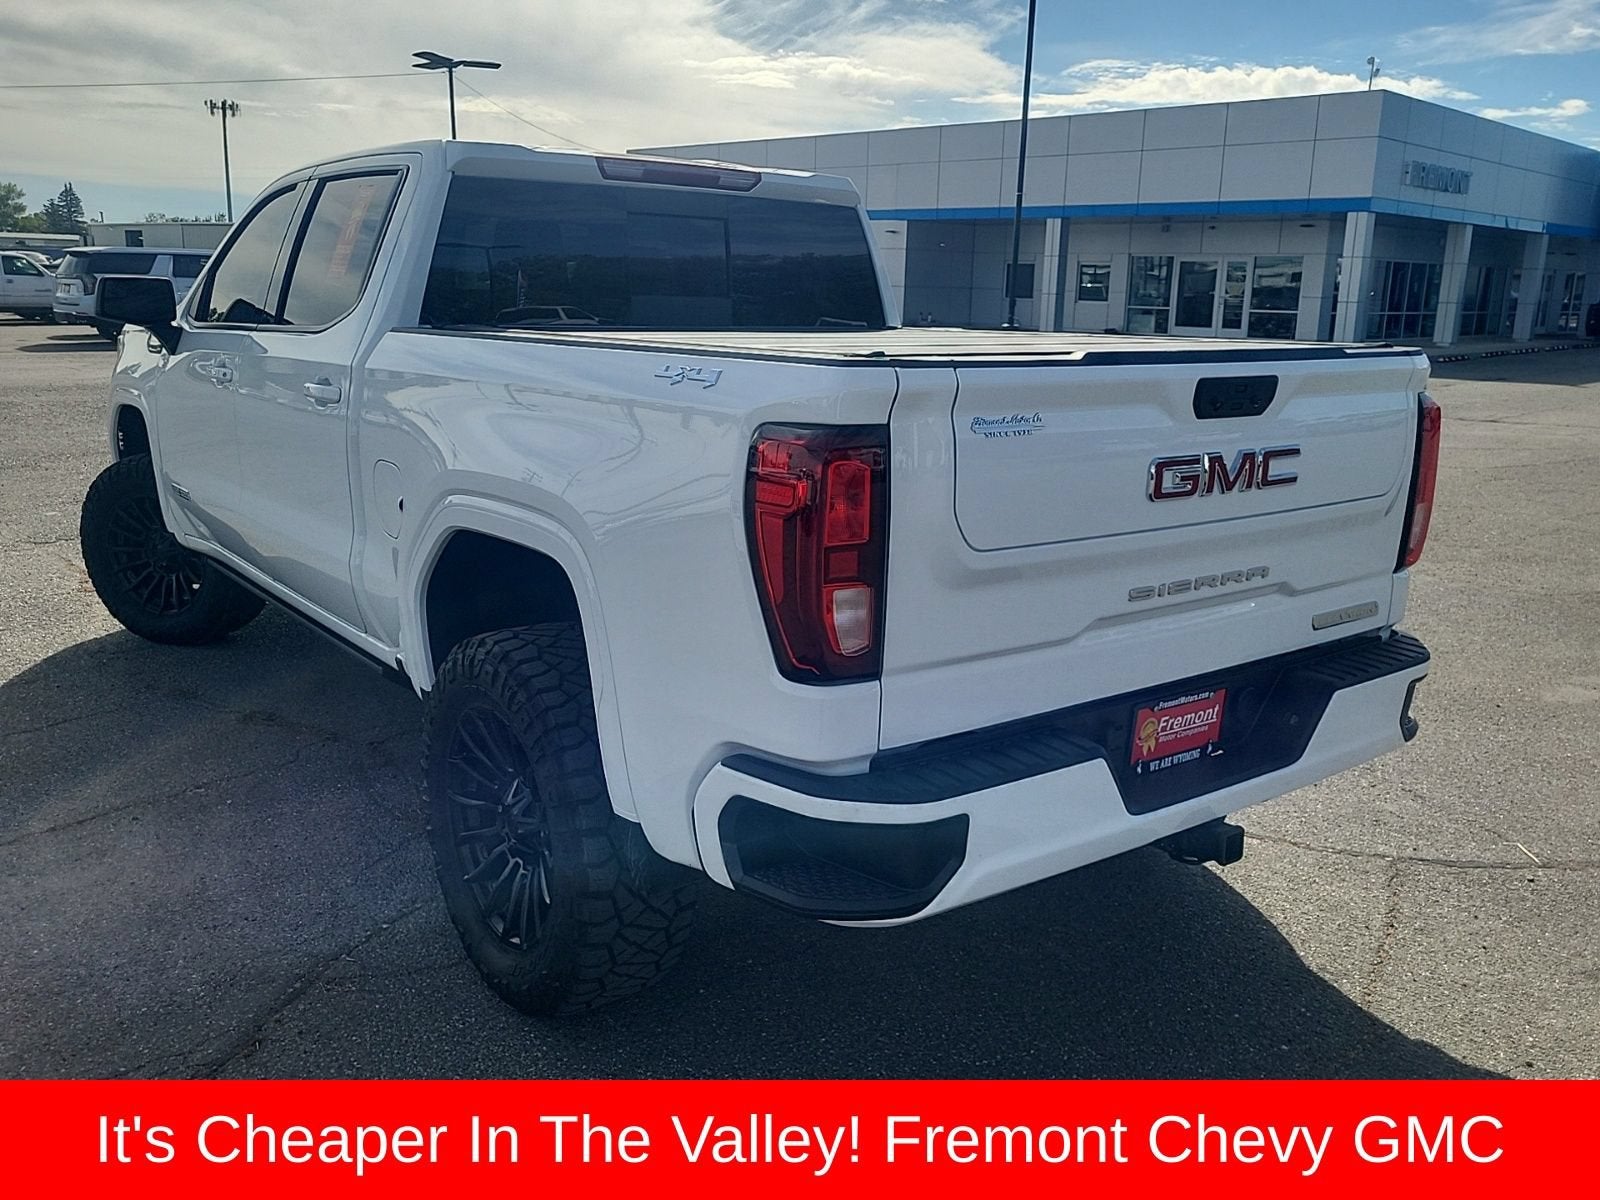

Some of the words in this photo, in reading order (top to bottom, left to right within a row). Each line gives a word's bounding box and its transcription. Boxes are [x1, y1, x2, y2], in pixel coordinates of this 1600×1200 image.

[1404, 160, 1473, 195] FREMONT
[1146, 444, 1301, 502] GMC
[1128, 566, 1270, 602] SIERRA
[1158, 704, 1219, 732] Fremont
[1159, 733, 1177, 742] Motor
[1150, 760, 1159, 771] WE
[1160, 756, 1172, 768] ARE
[1173, 749, 1201, 764] WYOMING
